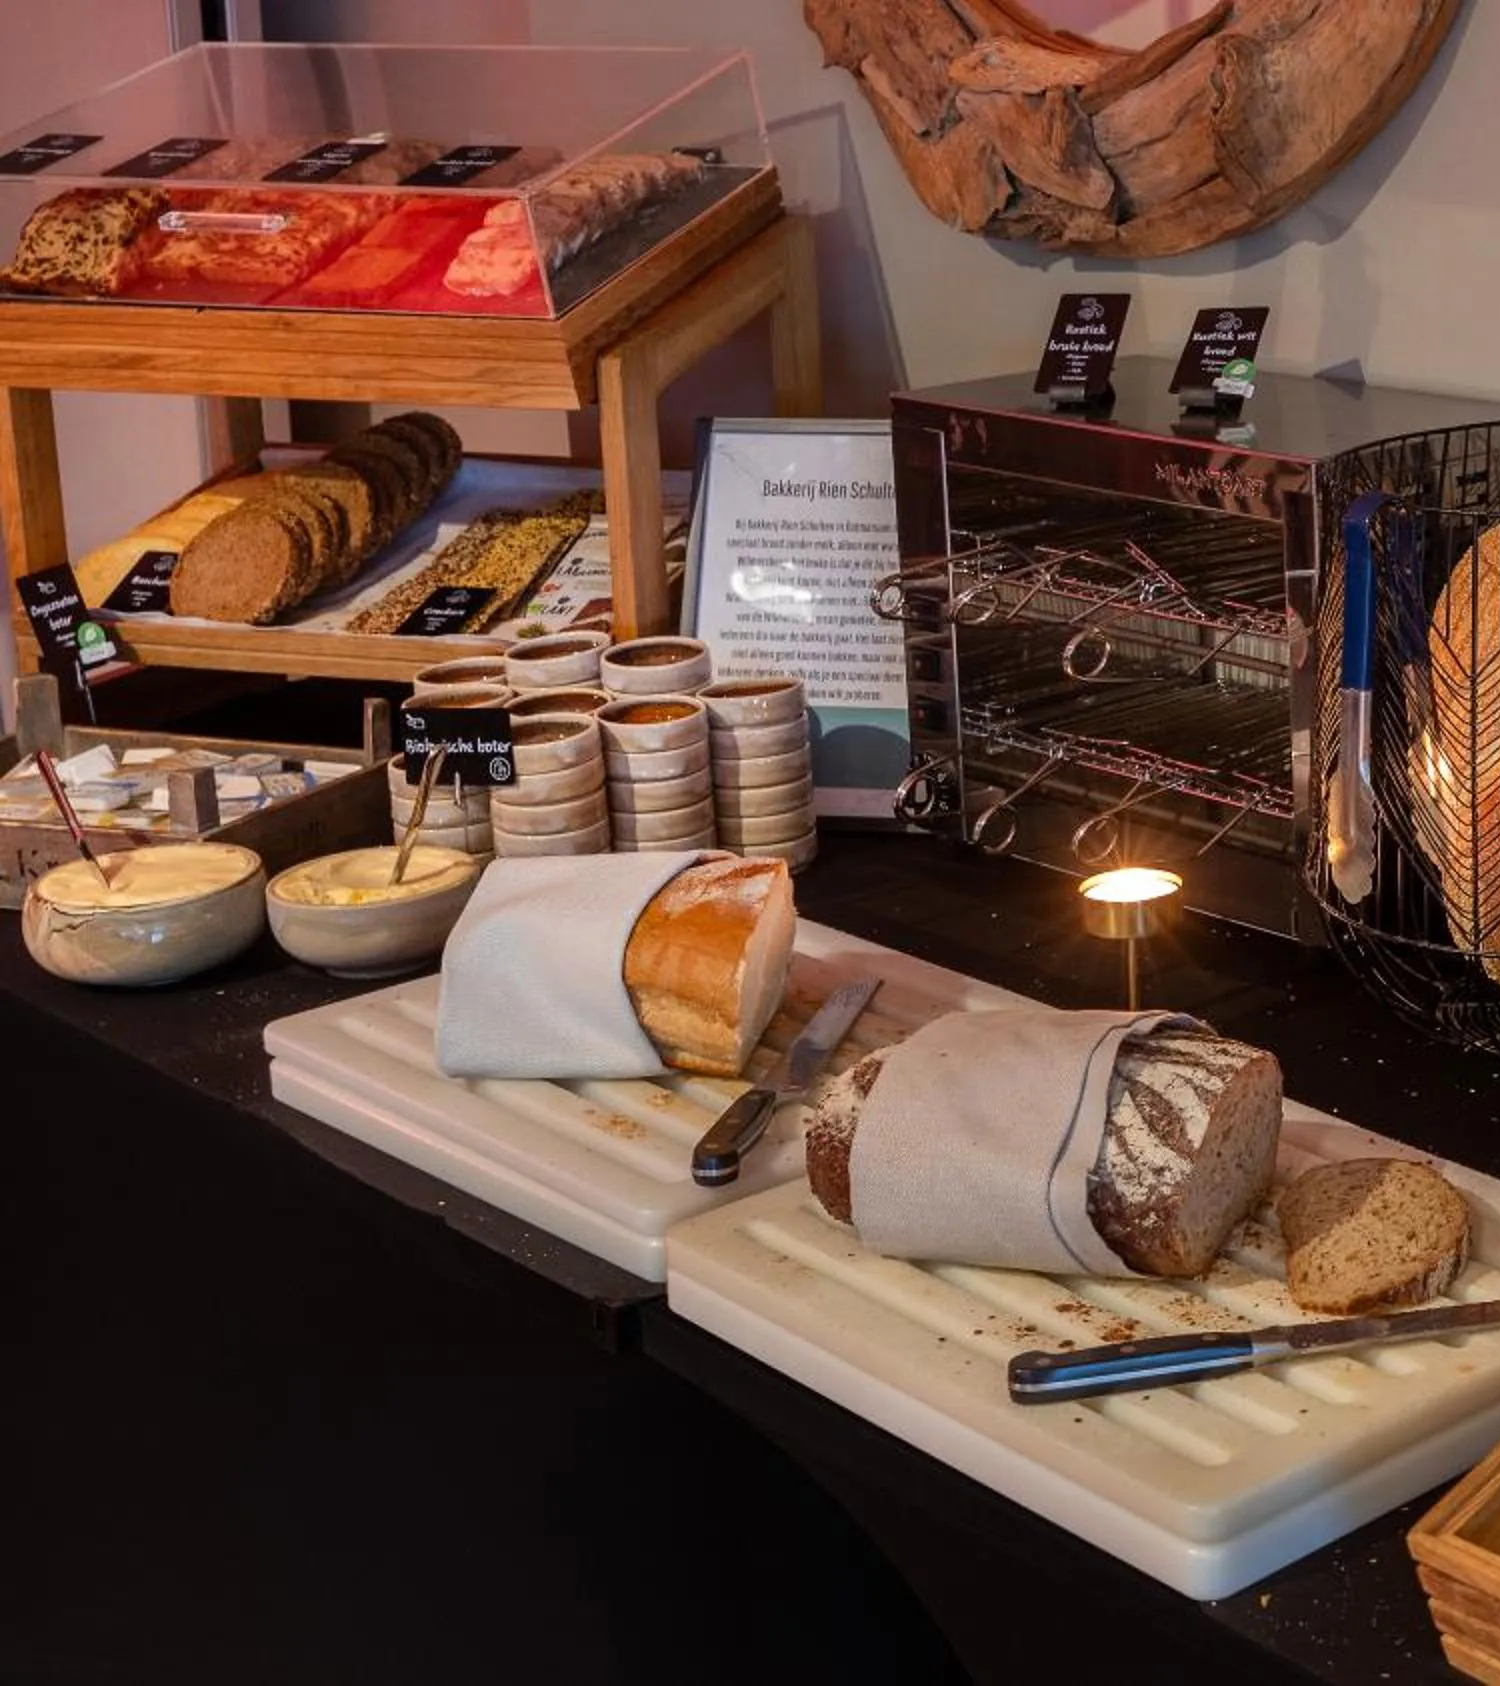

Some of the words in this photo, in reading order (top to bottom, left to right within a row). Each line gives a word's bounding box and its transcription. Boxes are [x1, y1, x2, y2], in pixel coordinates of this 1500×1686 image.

[763, 479, 816, 501] Bakkerij
[819, 481, 848, 498] Rien
[478, 736, 512, 753] boter
